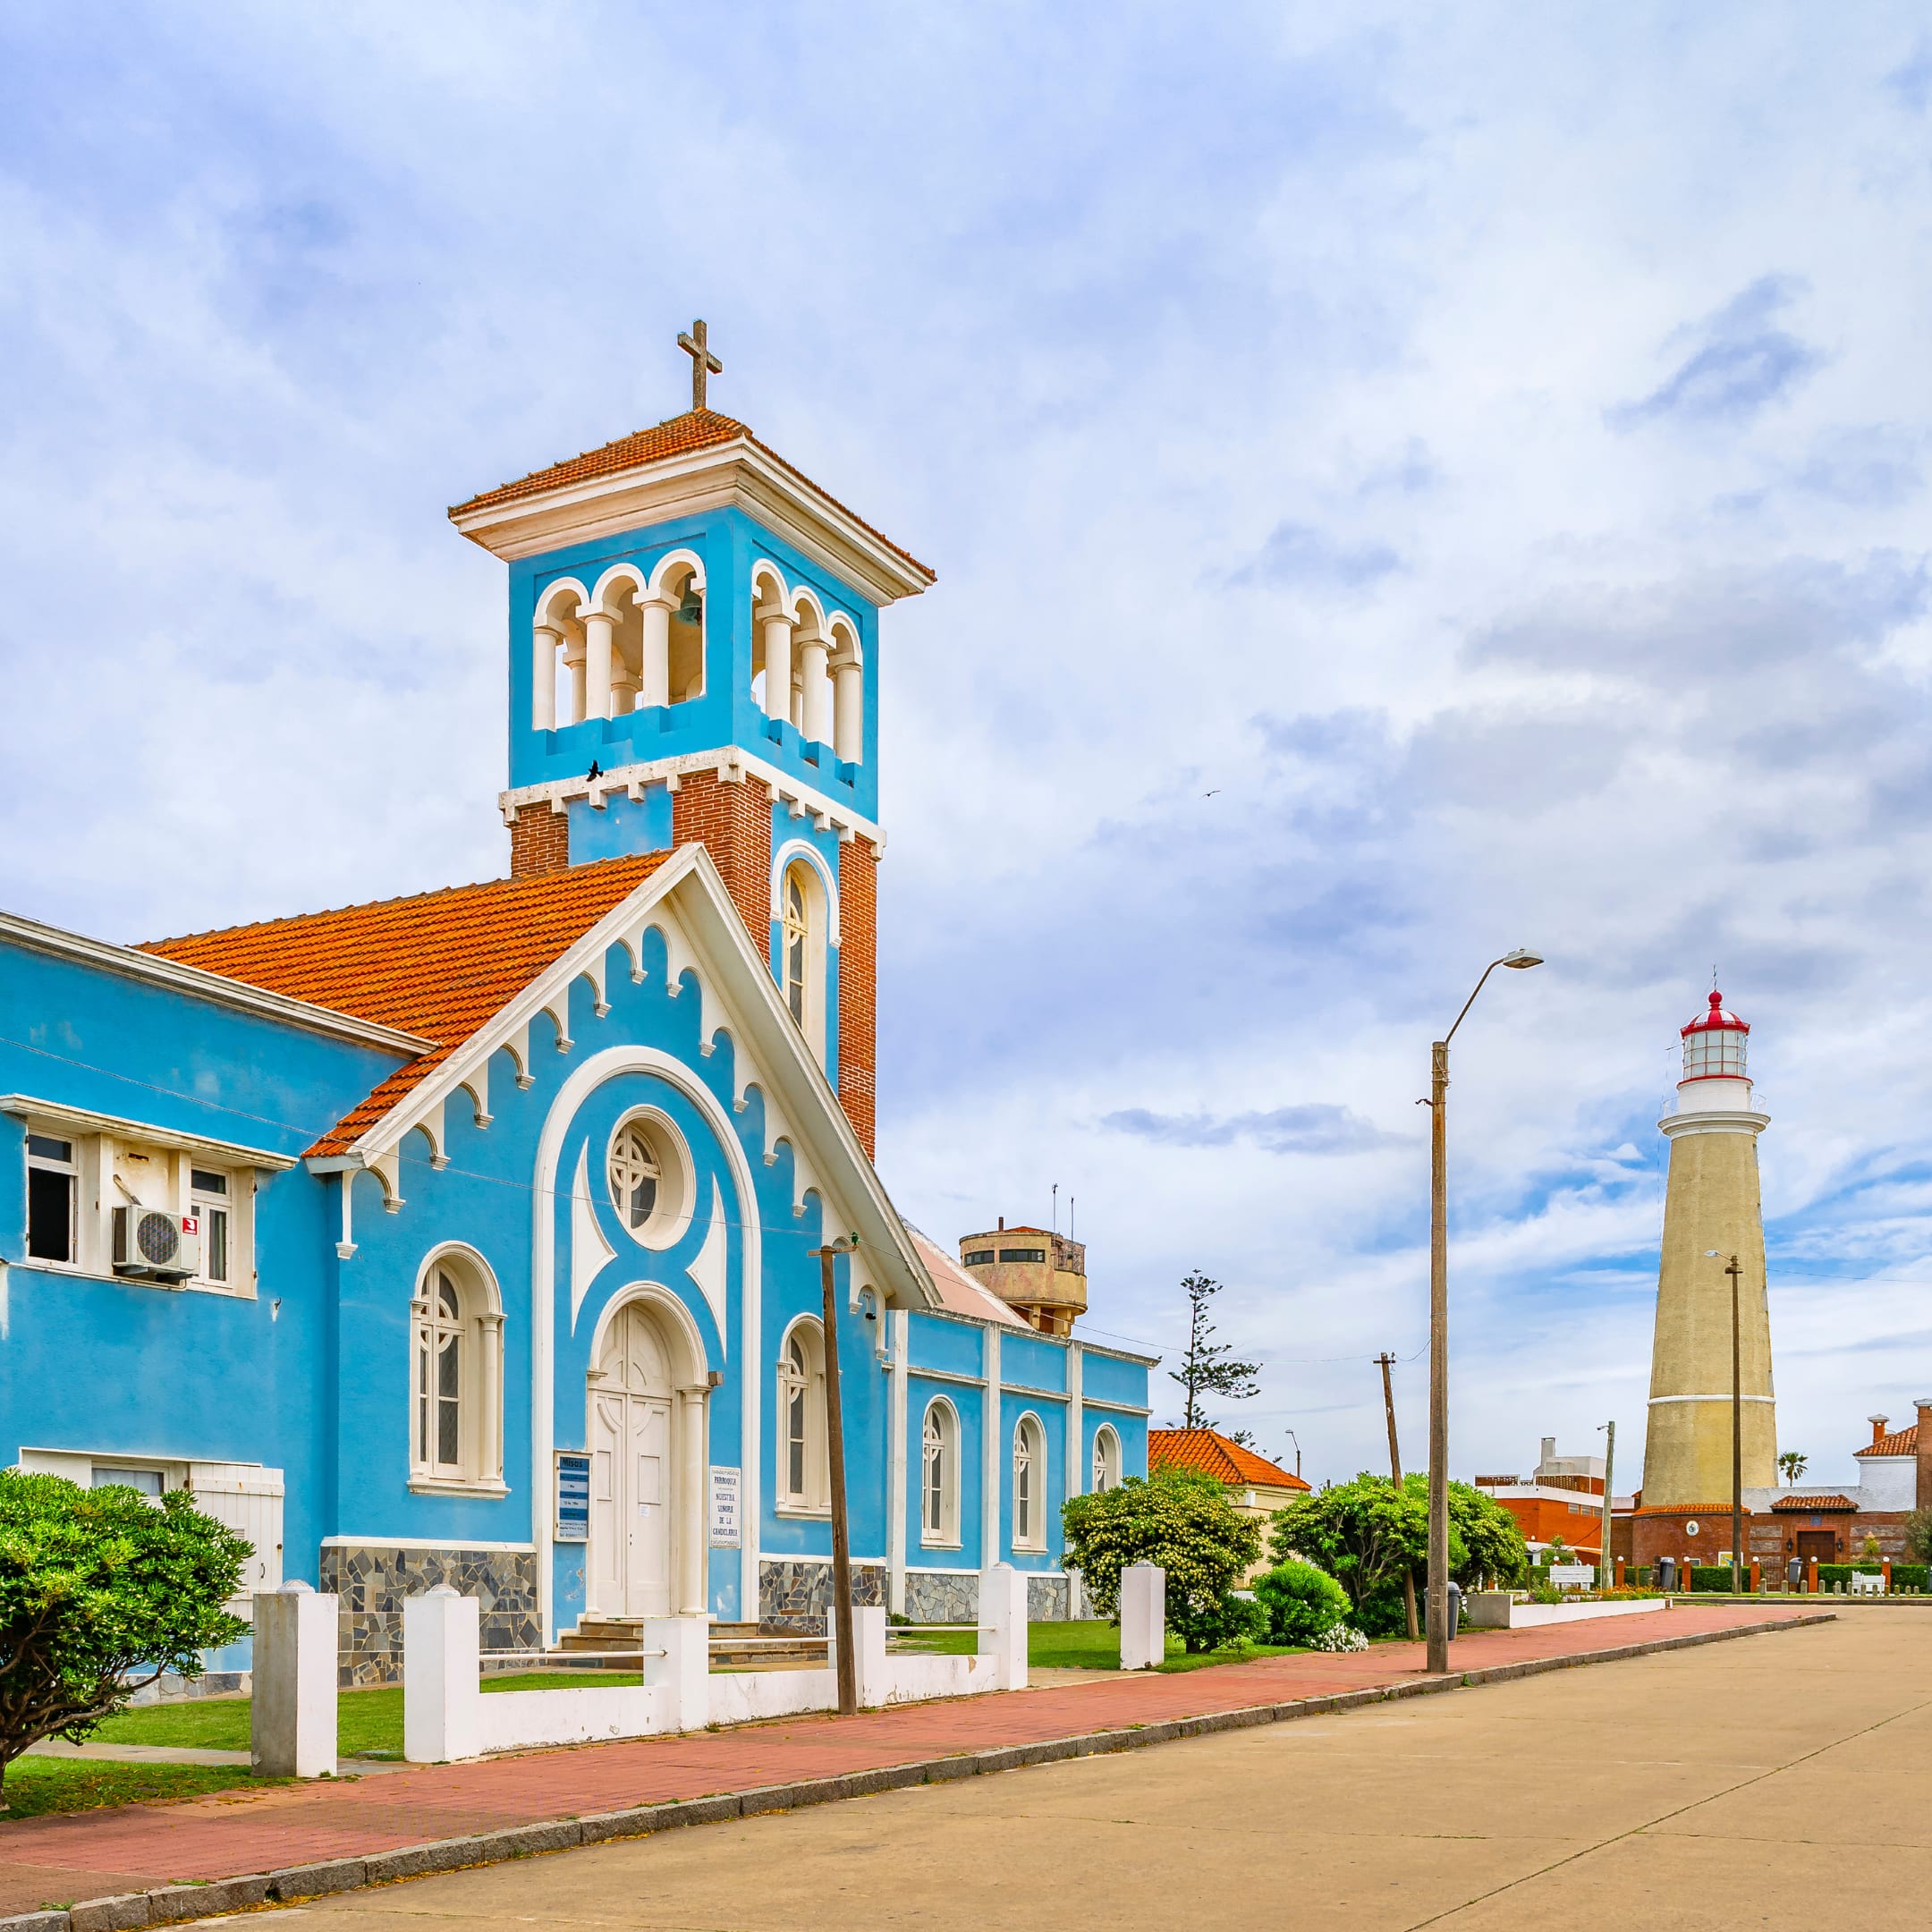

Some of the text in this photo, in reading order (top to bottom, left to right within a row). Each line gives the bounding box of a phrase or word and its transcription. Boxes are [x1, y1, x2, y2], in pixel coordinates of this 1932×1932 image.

[563, 1459, 583, 1468] Misas
[714, 1476, 737, 1486] PARROQUIA
[716, 1493, 735, 1502] NUESTRA
[726, 1517, 732, 1525] LA
[713, 1528, 738, 1536] CANDELARIA
